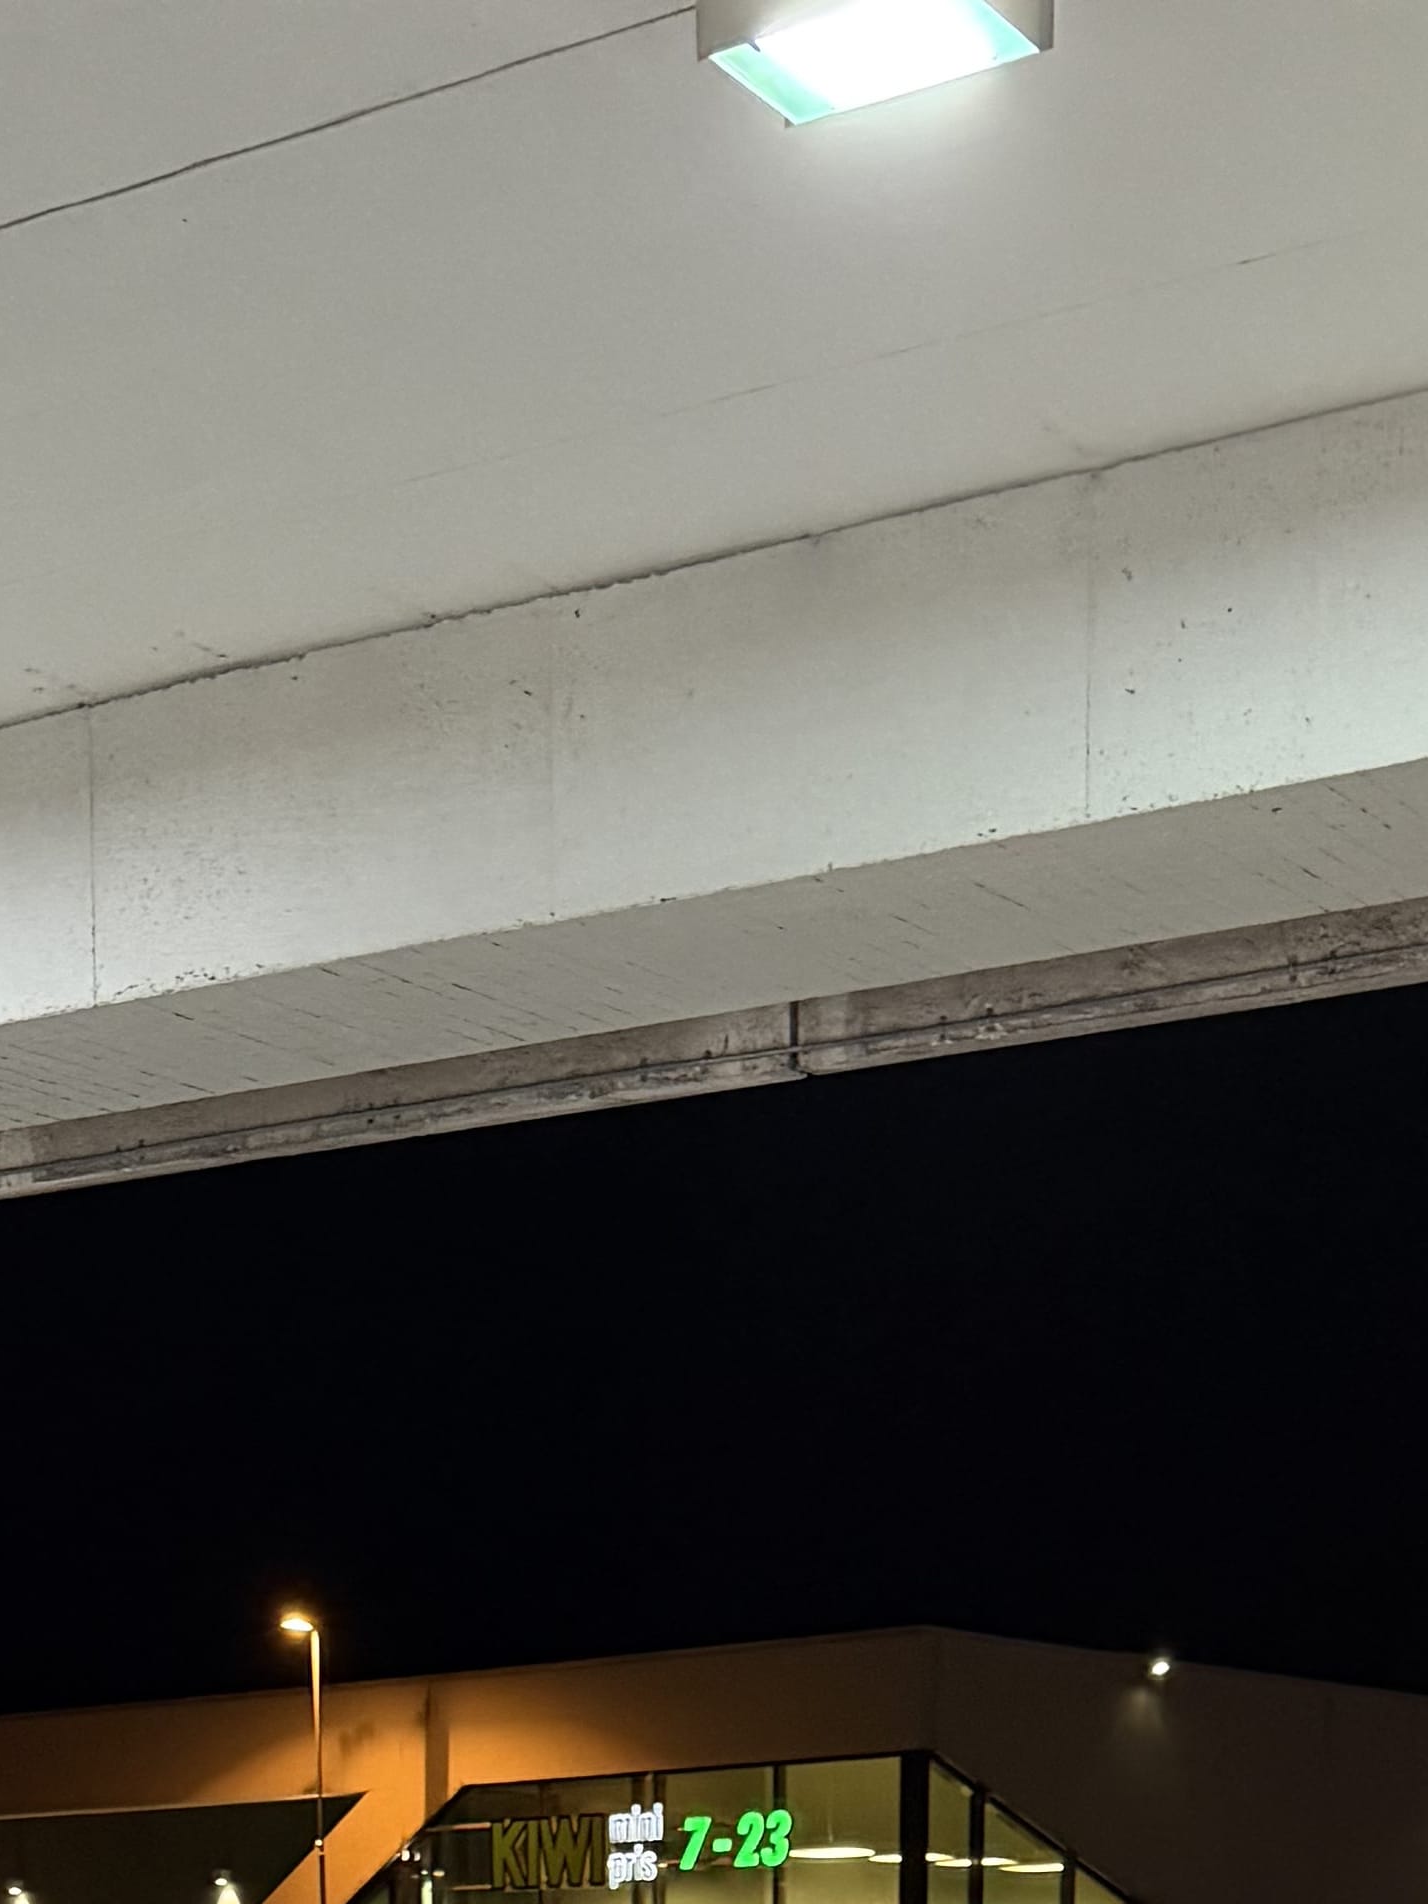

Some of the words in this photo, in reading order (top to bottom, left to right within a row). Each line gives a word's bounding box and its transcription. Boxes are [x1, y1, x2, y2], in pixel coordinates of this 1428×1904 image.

[609, 1802, 664, 1844] mini
[679, 1809, 793, 1871] 7-23
[490, 1812, 607, 1890] KIWI
[608, 1843, 659, 1890] pris
